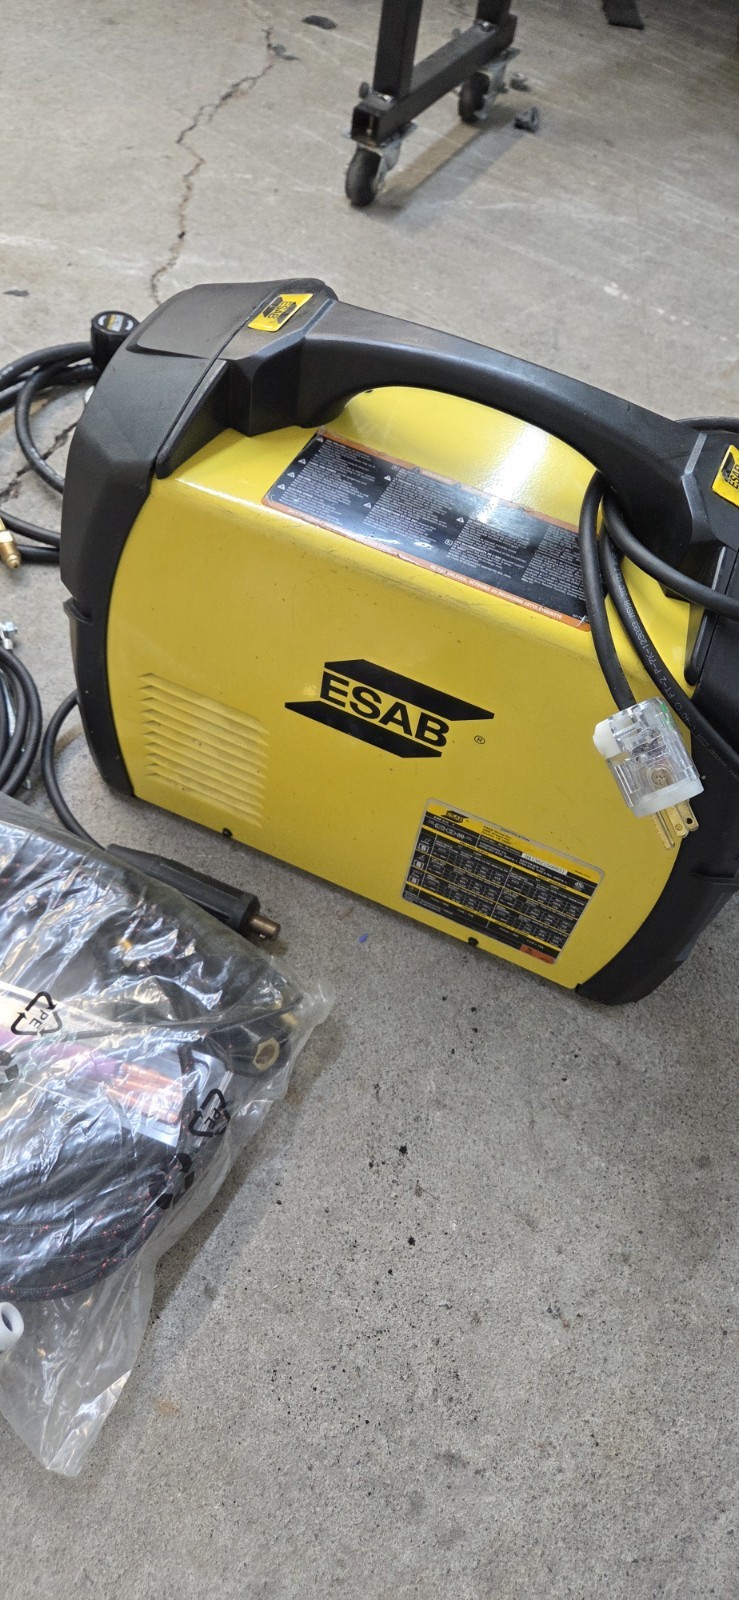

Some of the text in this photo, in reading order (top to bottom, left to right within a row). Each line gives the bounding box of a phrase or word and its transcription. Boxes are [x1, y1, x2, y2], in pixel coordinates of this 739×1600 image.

[267, 300, 292, 318] ESAB
[658, 675, 675, 698] FT-2
[319, 670, 450, 747] ESAB
[29, 1008, 48, 1028] PE
[204, 1108, 222, 1128] PE
